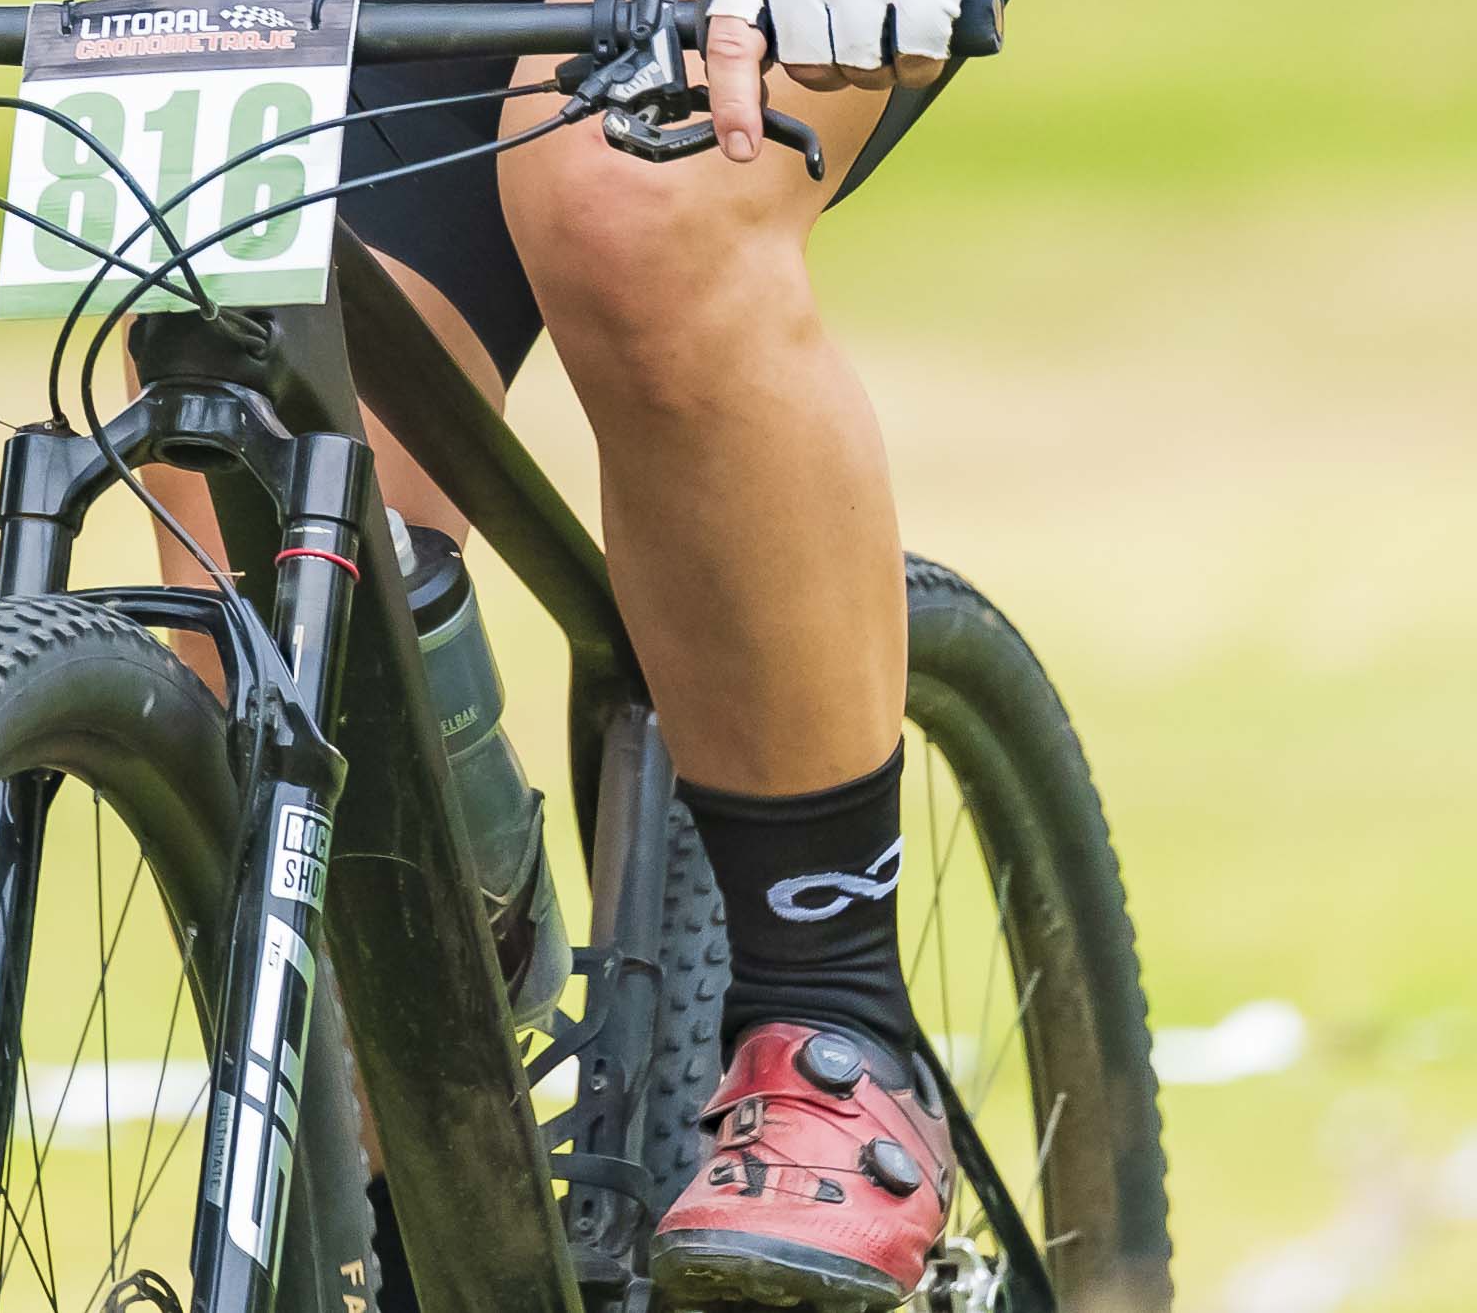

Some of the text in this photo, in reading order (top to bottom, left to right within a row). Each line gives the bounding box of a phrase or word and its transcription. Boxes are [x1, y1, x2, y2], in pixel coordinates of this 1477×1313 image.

[74, 29, 298, 60] CRONOMETRAJE
[79, 8, 220, 40] LITORAL
[32, 81, 313, 272] 816
[283, 812, 330, 862] ROC
[283, 858, 325, 899] SHO
